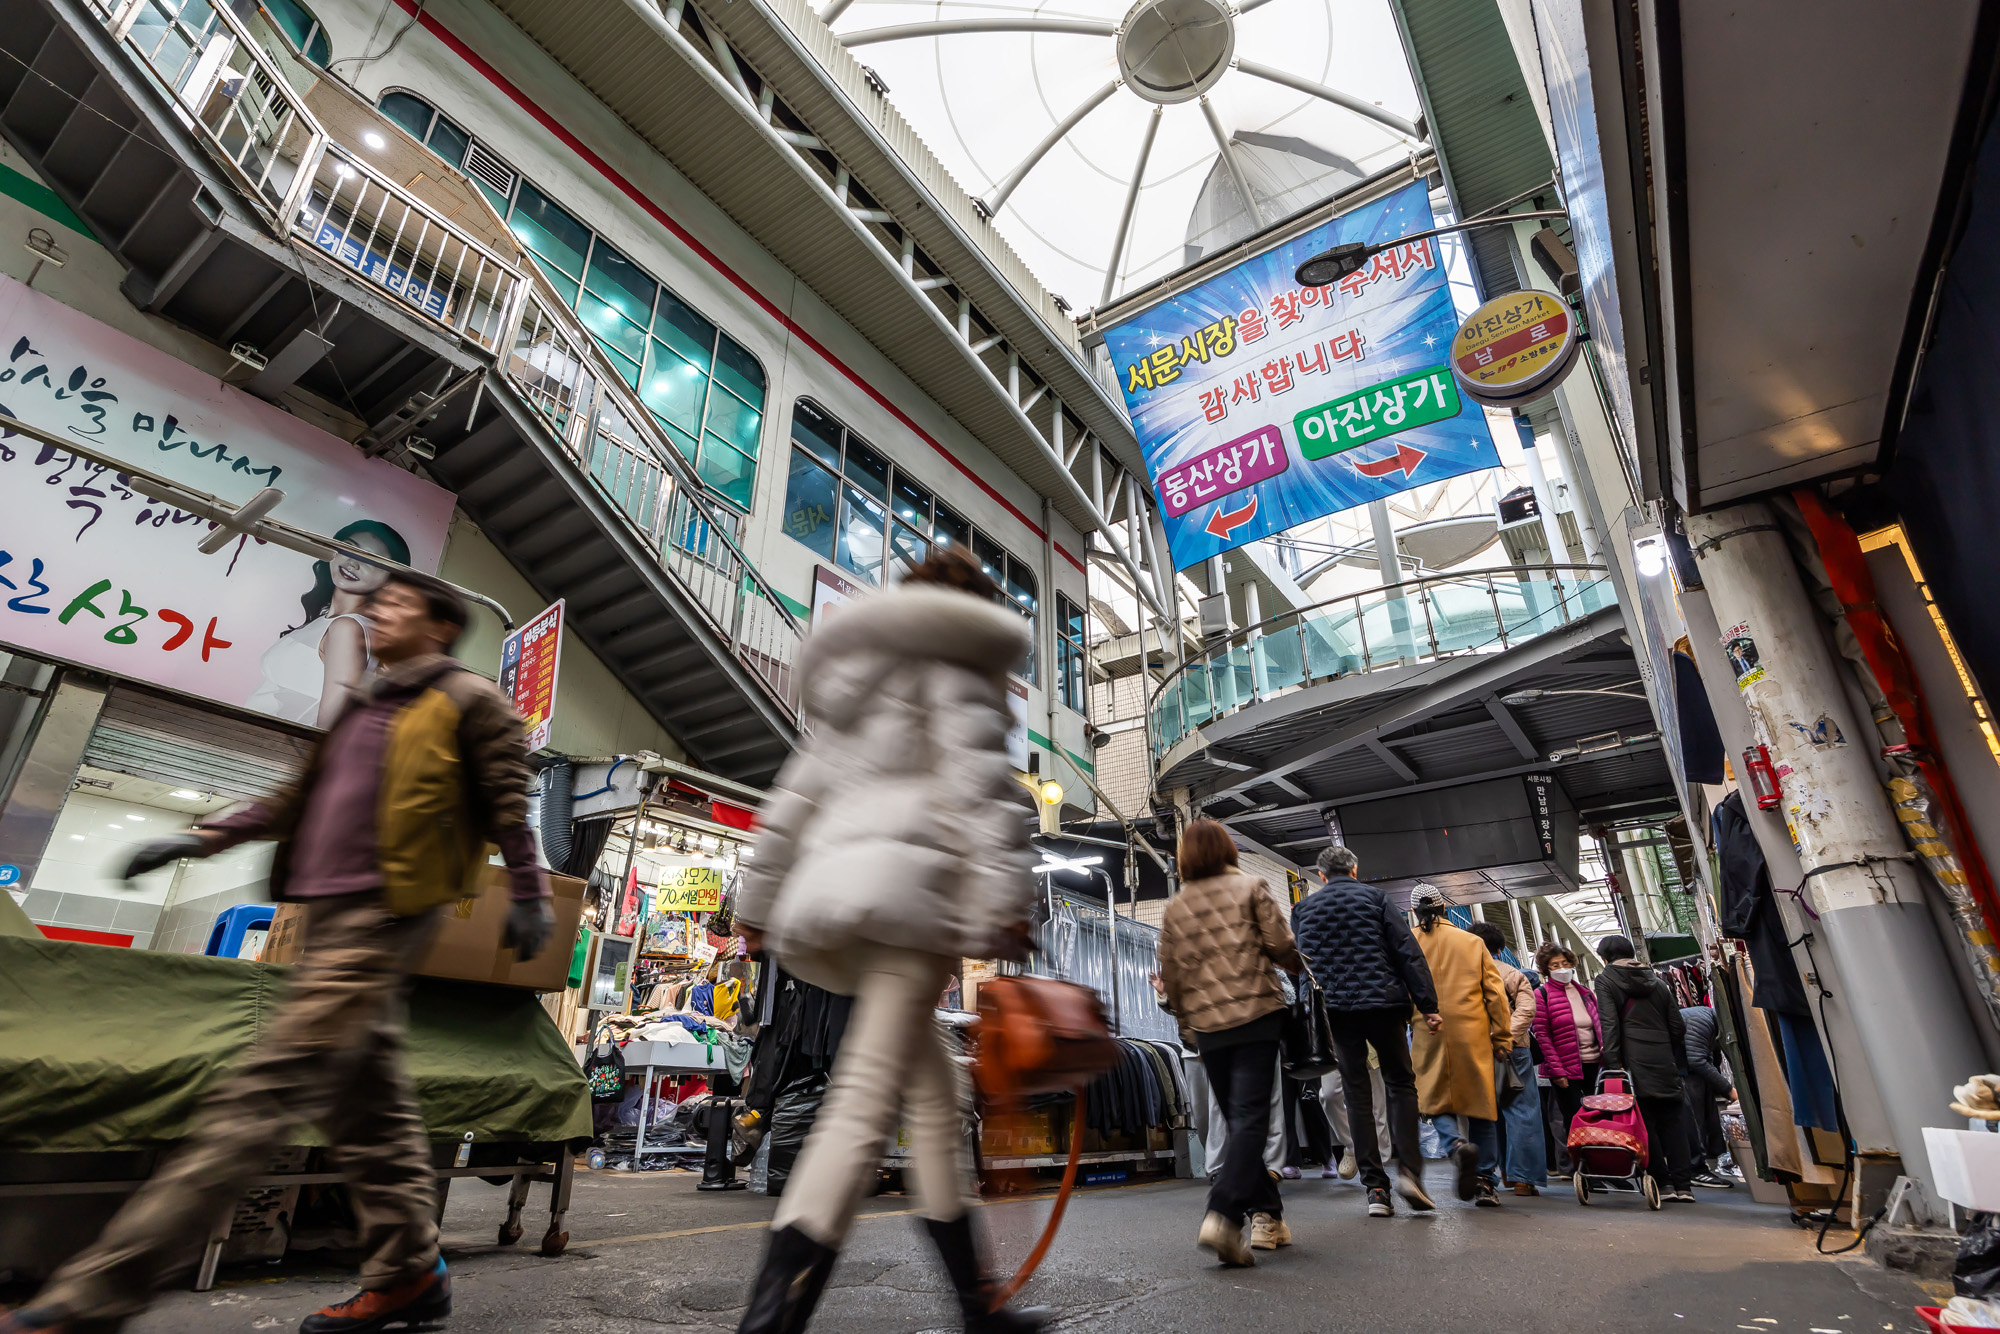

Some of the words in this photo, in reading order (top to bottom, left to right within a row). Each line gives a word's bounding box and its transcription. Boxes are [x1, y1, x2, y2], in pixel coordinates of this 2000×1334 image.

[1127, 307, 1266, 394] 서문시장을
[1269, 283, 1332, 329] 찾아
[1339, 238, 1435, 296] 주셔서
[1464, 296, 1544, 340] 아진상가
[1465, 338, 1490, 352] Daegu
[1491, 322, 1521, 340] Seomun
[1522, 310, 1551, 327] Market
[1474, 346, 1495, 366] 남
[1530, 323, 1551, 344] 로
[1198, 328, 1367, 424] 감사합니다
[1301, 376, 1449, 443] 아진상가
[132, 411, 283, 488] 만나서
[1164, 435, 1277, 507] 동산상가
[1527, 775, 1552, 783] 서문시장
[1536, 786, 1549, 817] 만남의
[1541, 819, 1552, 840] 장소
[1545, 842, 1552, 853] 1
[661, 867, 718, 887] 신상모자
